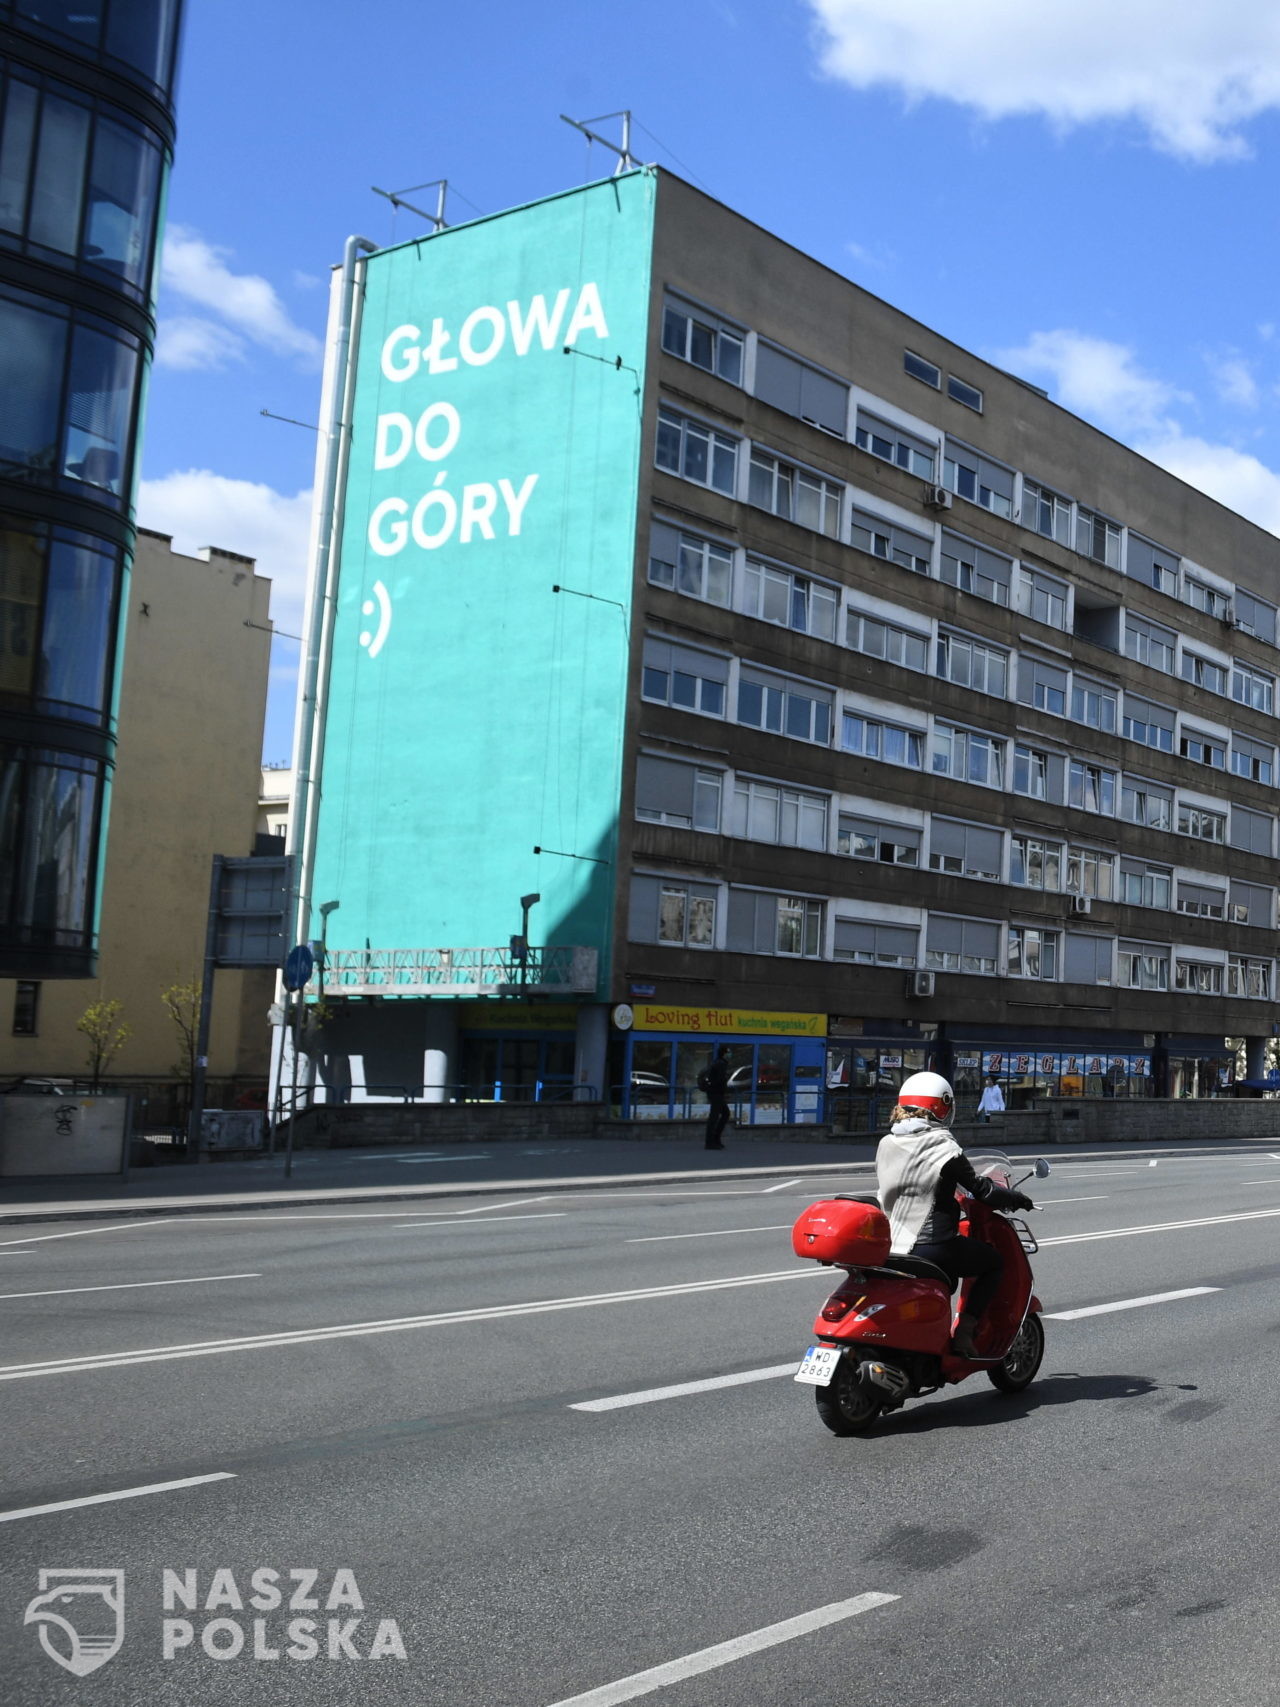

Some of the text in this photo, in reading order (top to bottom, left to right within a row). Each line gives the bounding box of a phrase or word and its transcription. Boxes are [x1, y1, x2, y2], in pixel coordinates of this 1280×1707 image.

[381, 282, 609, 382] GŁOWA
[375, 402, 461, 471] DO
[368, 470, 540, 557] GÓRY
[645, 1008, 701, 1030] Loving
[801, 1364, 831, 1377] 2863
[815, 1351, 831, 1363] WD
